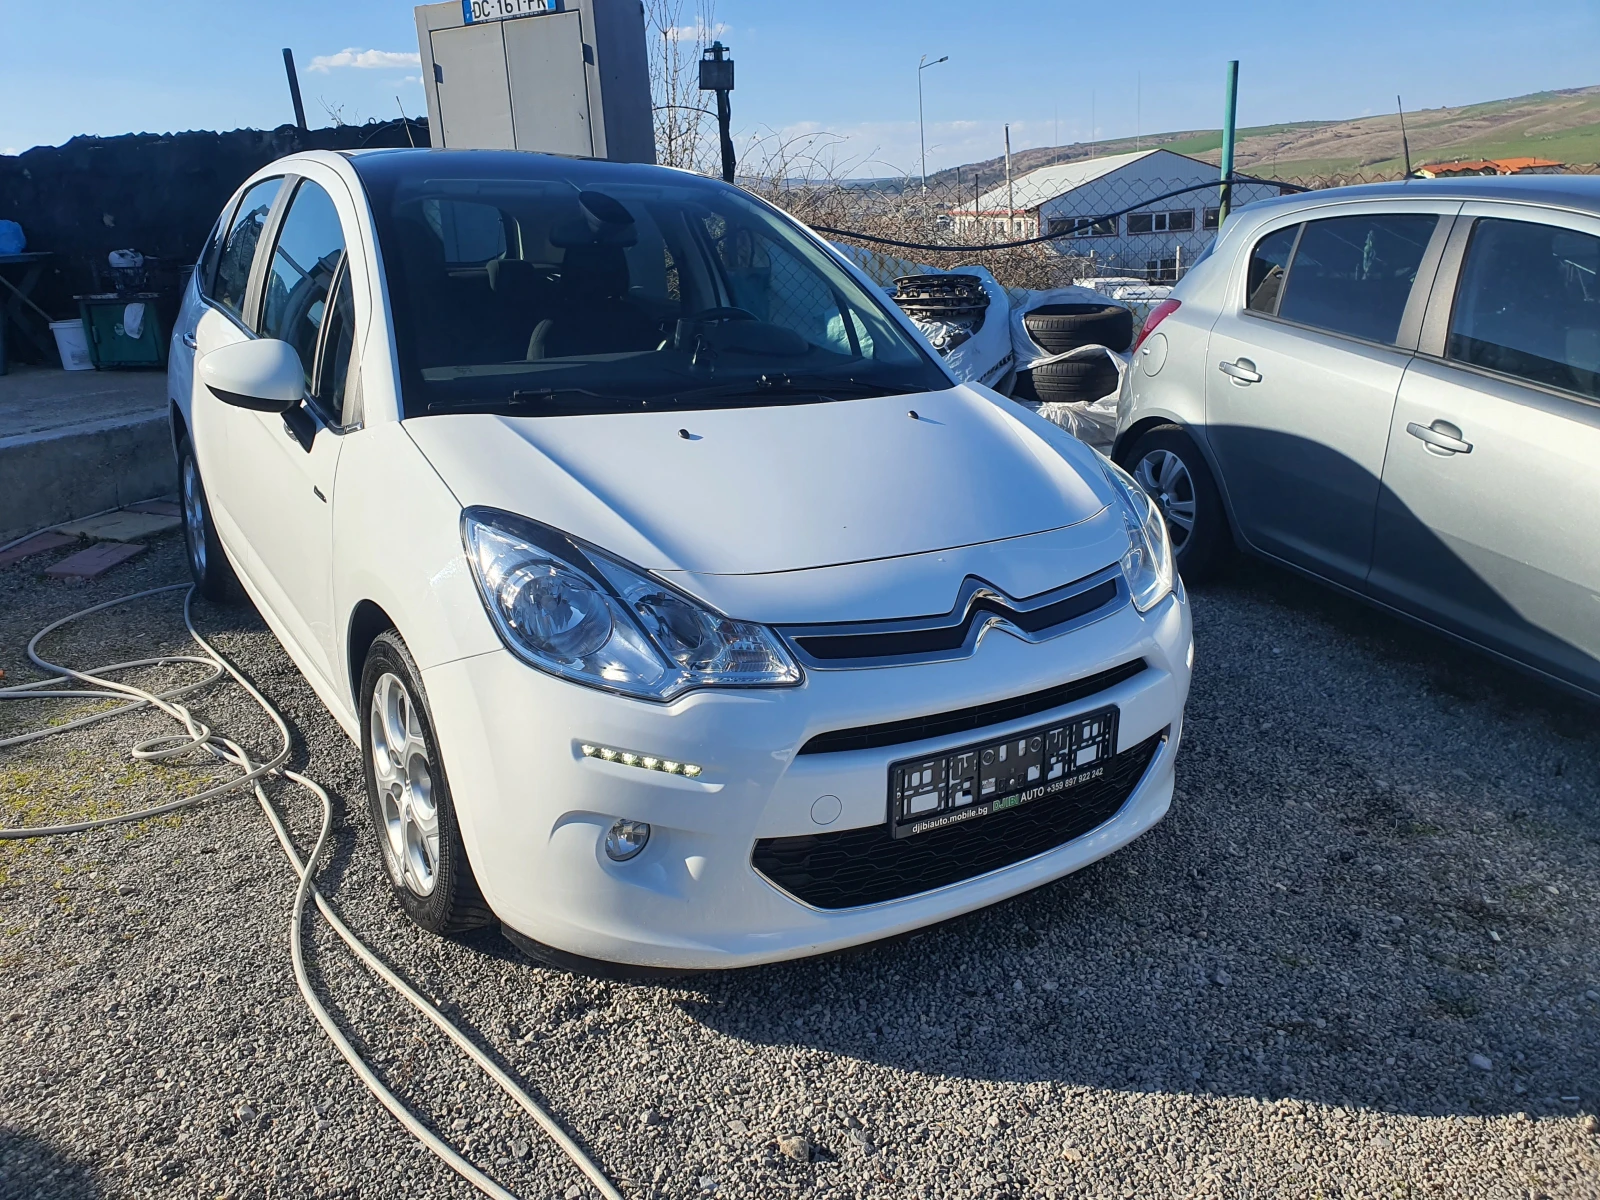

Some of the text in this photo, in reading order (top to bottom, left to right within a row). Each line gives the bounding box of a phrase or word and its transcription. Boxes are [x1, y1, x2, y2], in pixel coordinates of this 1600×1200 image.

[993, 767, 1104, 812] DJIBI AUTO +359 897 922 242
[912, 807, 988, 834] djibiauto.mobile.bg
